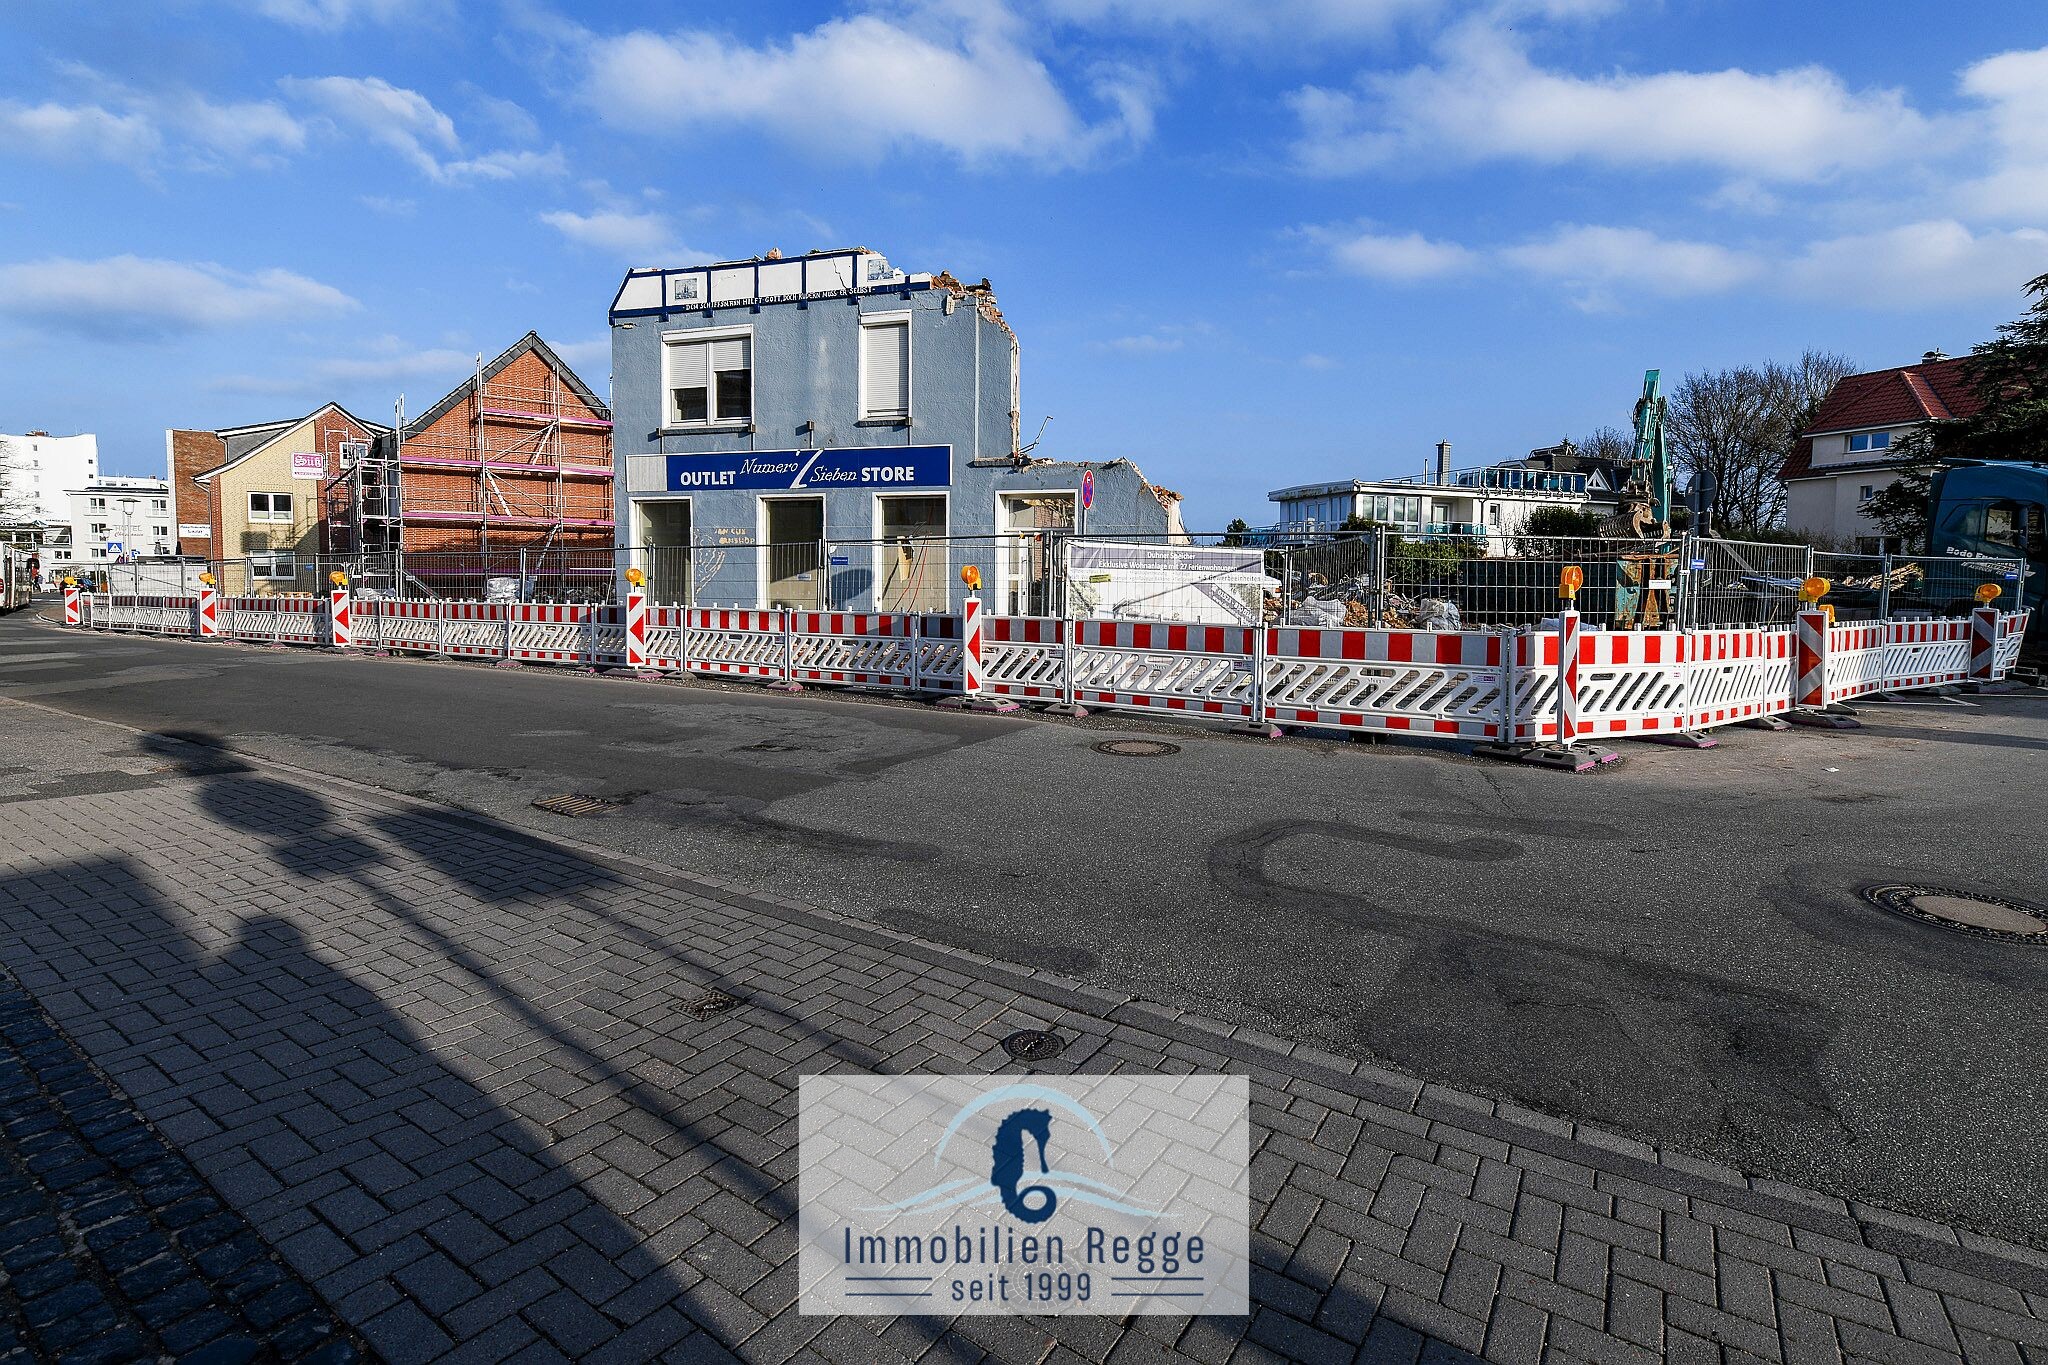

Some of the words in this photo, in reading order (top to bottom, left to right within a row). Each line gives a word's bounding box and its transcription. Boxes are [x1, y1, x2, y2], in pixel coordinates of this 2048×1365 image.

[743, 297, 762, 305] HILFT
[680, 470, 736, 486] OUTLET
[740, 458, 799, 475] Numero
[809, 465, 858, 483] Sieben
[861, 466, 915, 482] STORE
[1147, 551, 1169, 559] Duhner
[1170, 552, 1196, 561] Speicher
[1945, 546, 1973, 558] Bodo
[1098, 560, 1129, 569] Exklusive
[1129, 561, 1167, 571] Wohnanlage
[1168, 562, 1179, 570] mit
